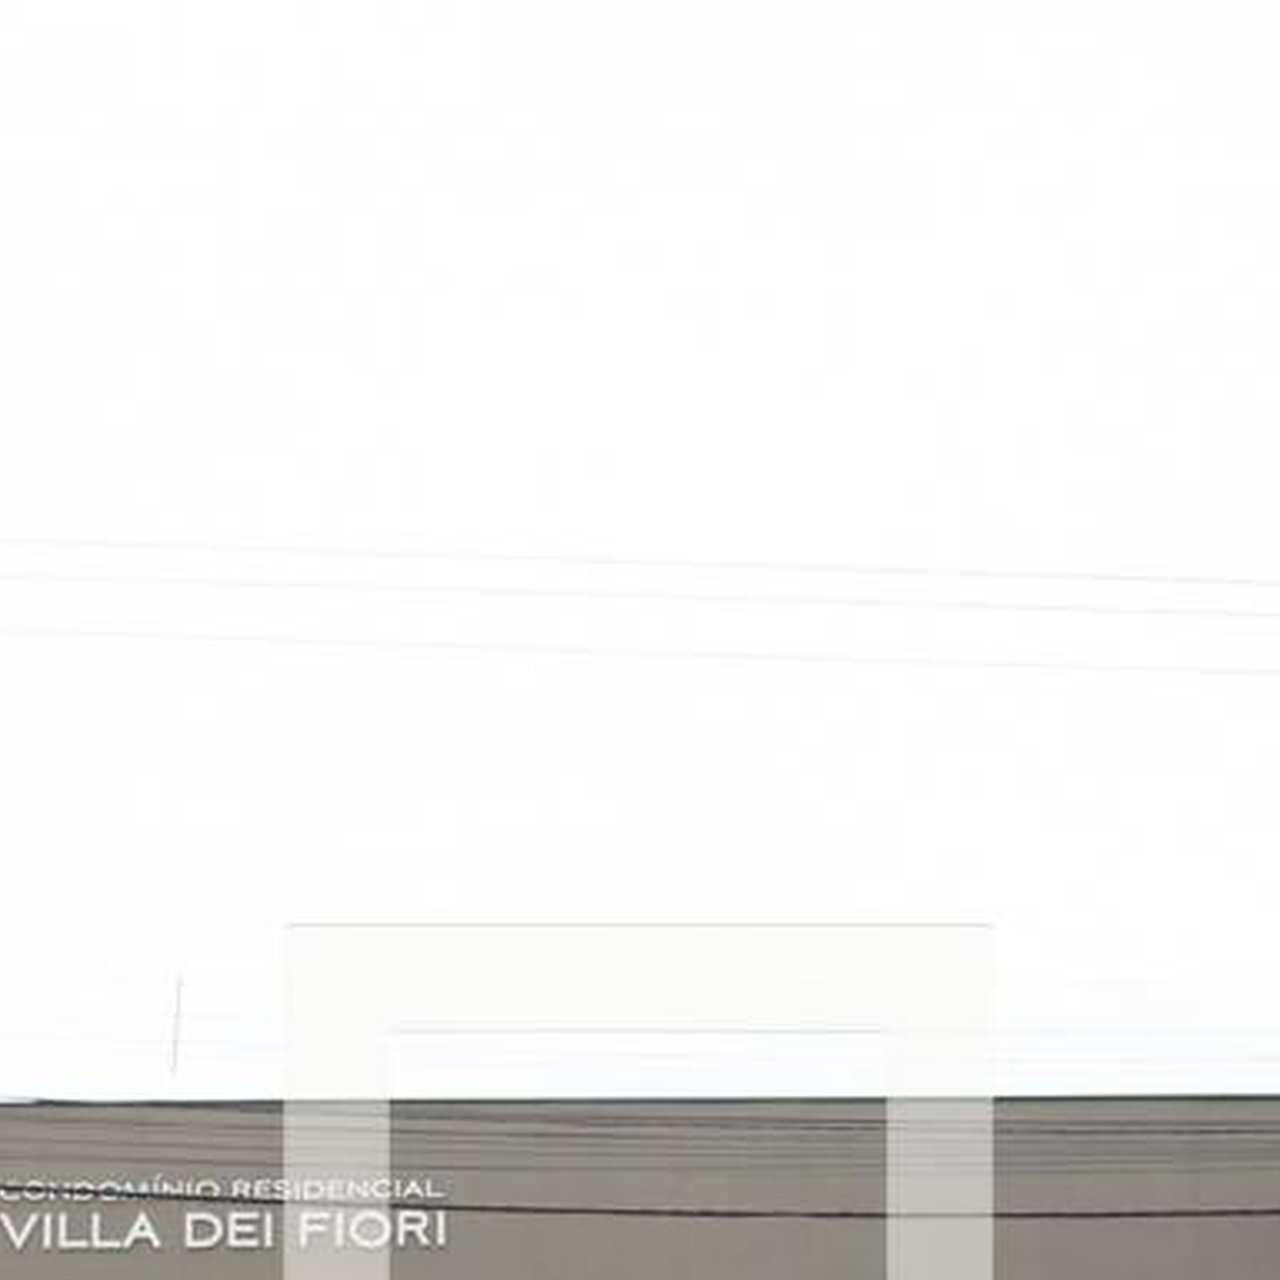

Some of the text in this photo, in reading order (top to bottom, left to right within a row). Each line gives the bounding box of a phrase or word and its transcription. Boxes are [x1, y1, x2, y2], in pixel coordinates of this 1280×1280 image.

[0, 1173, 447, 1202] CONDOMÍNIO RESIDENCIAL
[0, 1209, 446, 1250] VILLA DEI FIORI
